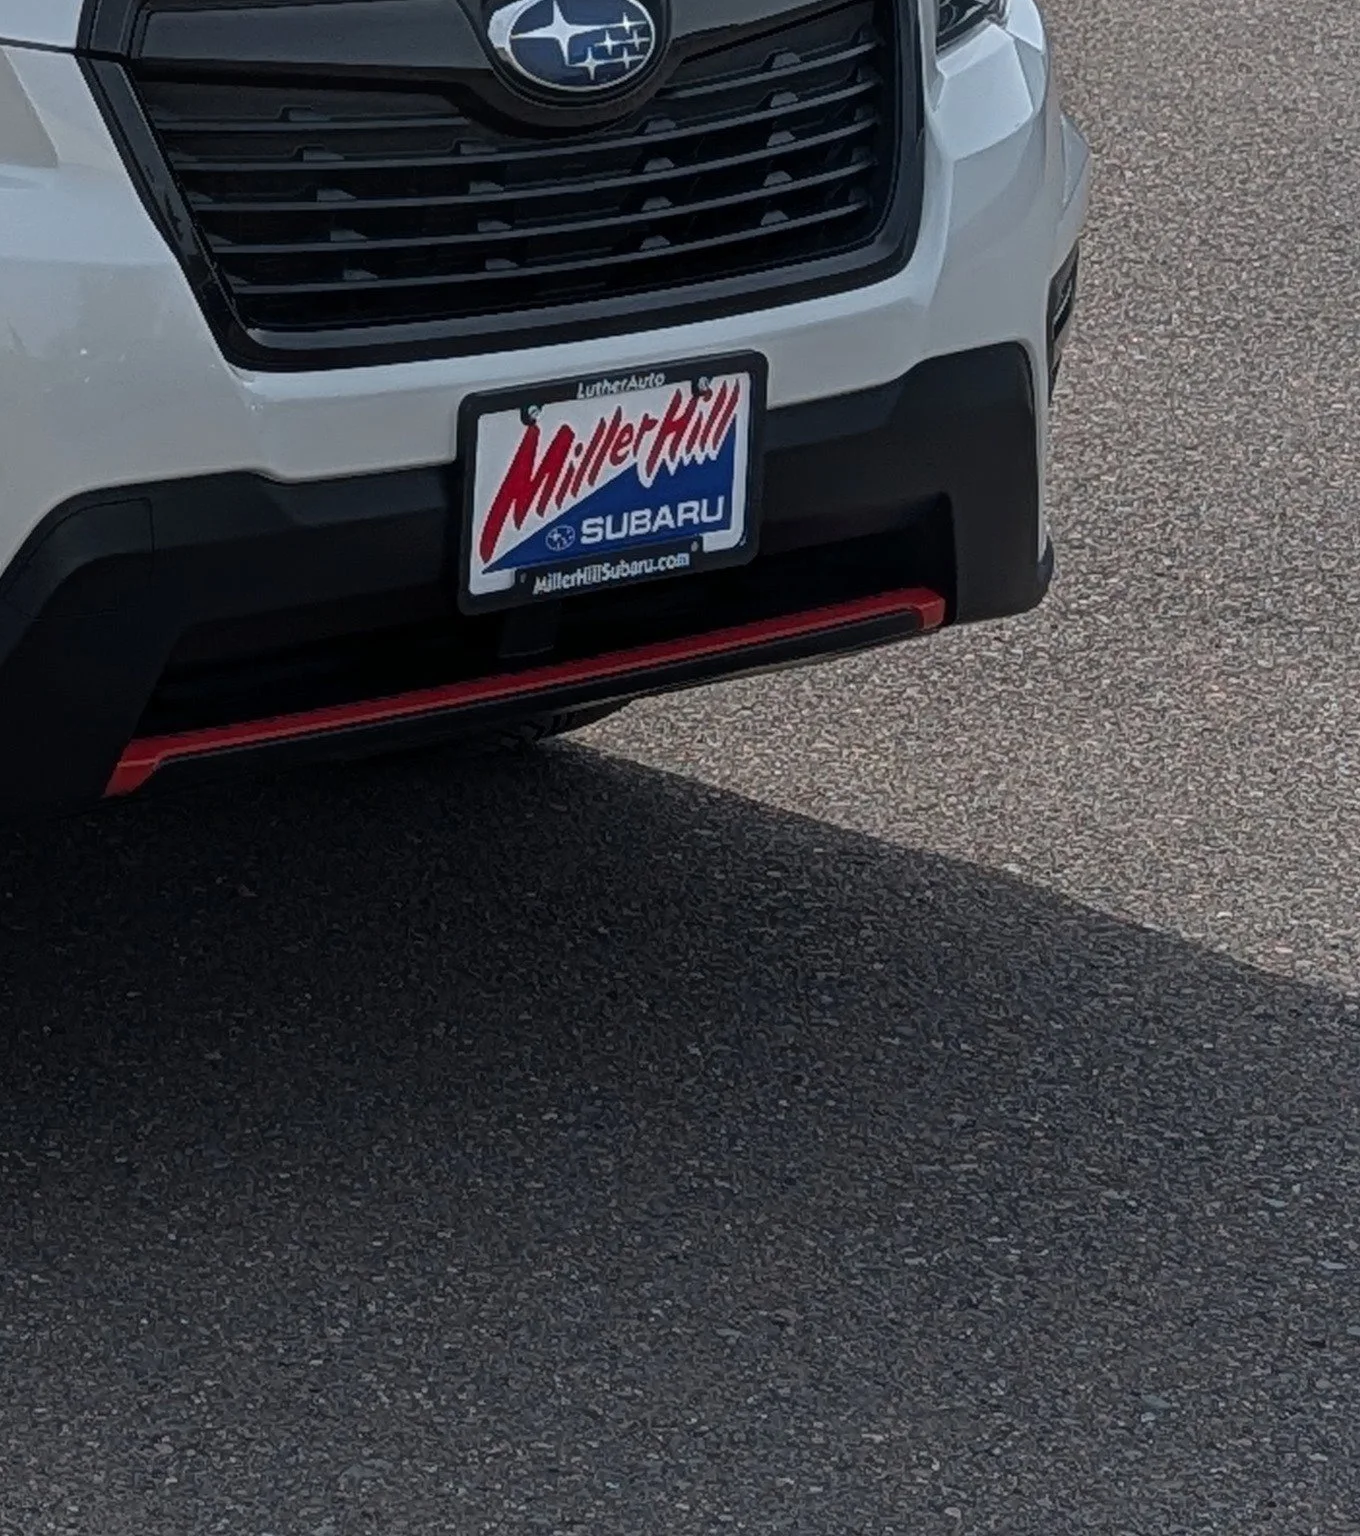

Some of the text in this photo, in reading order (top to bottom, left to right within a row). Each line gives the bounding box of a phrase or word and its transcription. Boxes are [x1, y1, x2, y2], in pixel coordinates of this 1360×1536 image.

[576, 372, 666, 399] LutherAuto
[480, 378, 741, 564] Miller Hill
[580, 495, 725, 545] SUBARU
[532, 552, 690, 595] MillerHillSubaru.com
